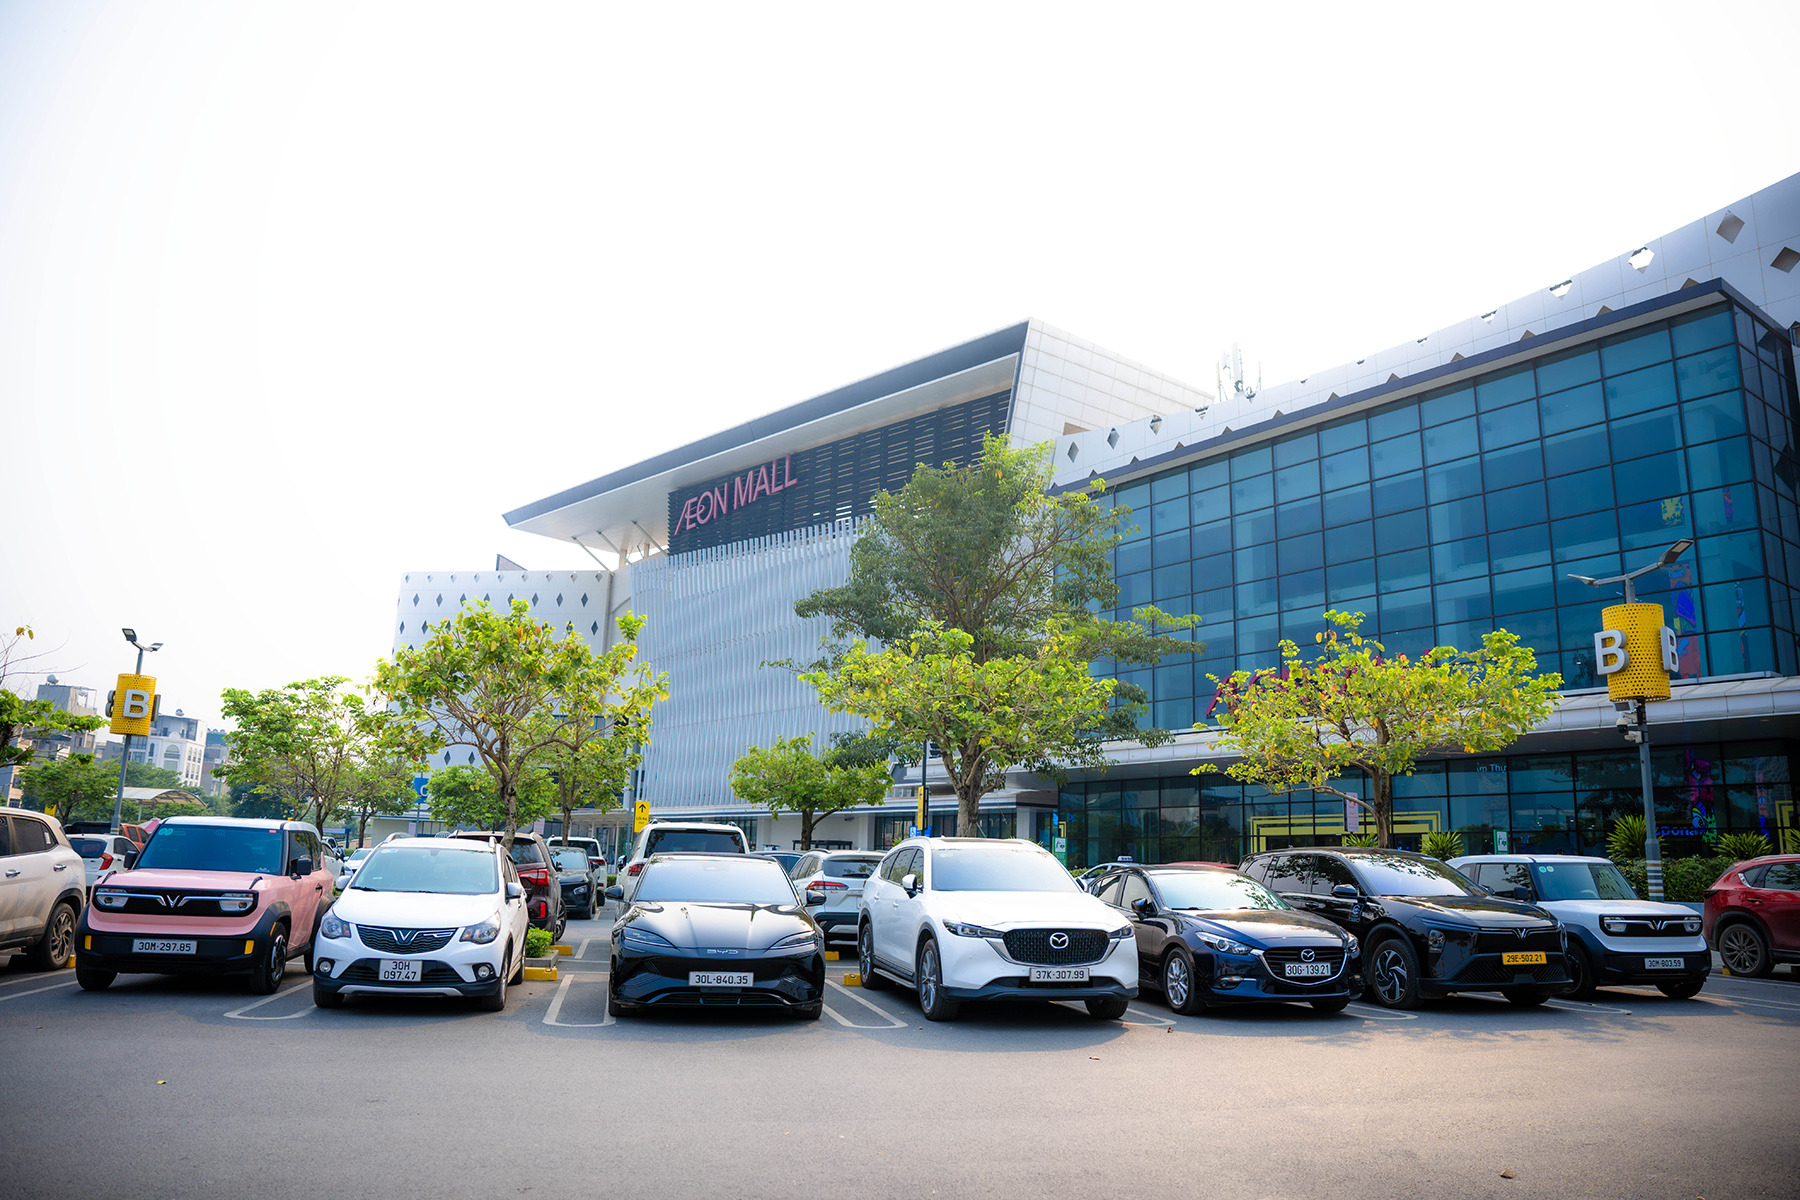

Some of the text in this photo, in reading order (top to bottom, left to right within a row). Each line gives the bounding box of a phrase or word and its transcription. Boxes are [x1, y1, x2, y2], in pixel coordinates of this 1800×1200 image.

[733, 453, 798, 510] MALL
[1594, 629, 1630, 675] B
[1660, 626, 1679, 673] B
[122, 689, 150, 719] B
[138, 941, 192, 952] 30M-297.85
[391, 961, 410, 971] 30H
[383, 970, 417, 981] 097.47
[694, 974, 749, 985] 30L-840.35
[1035, 970, 1085, 980] 37K-307.99
